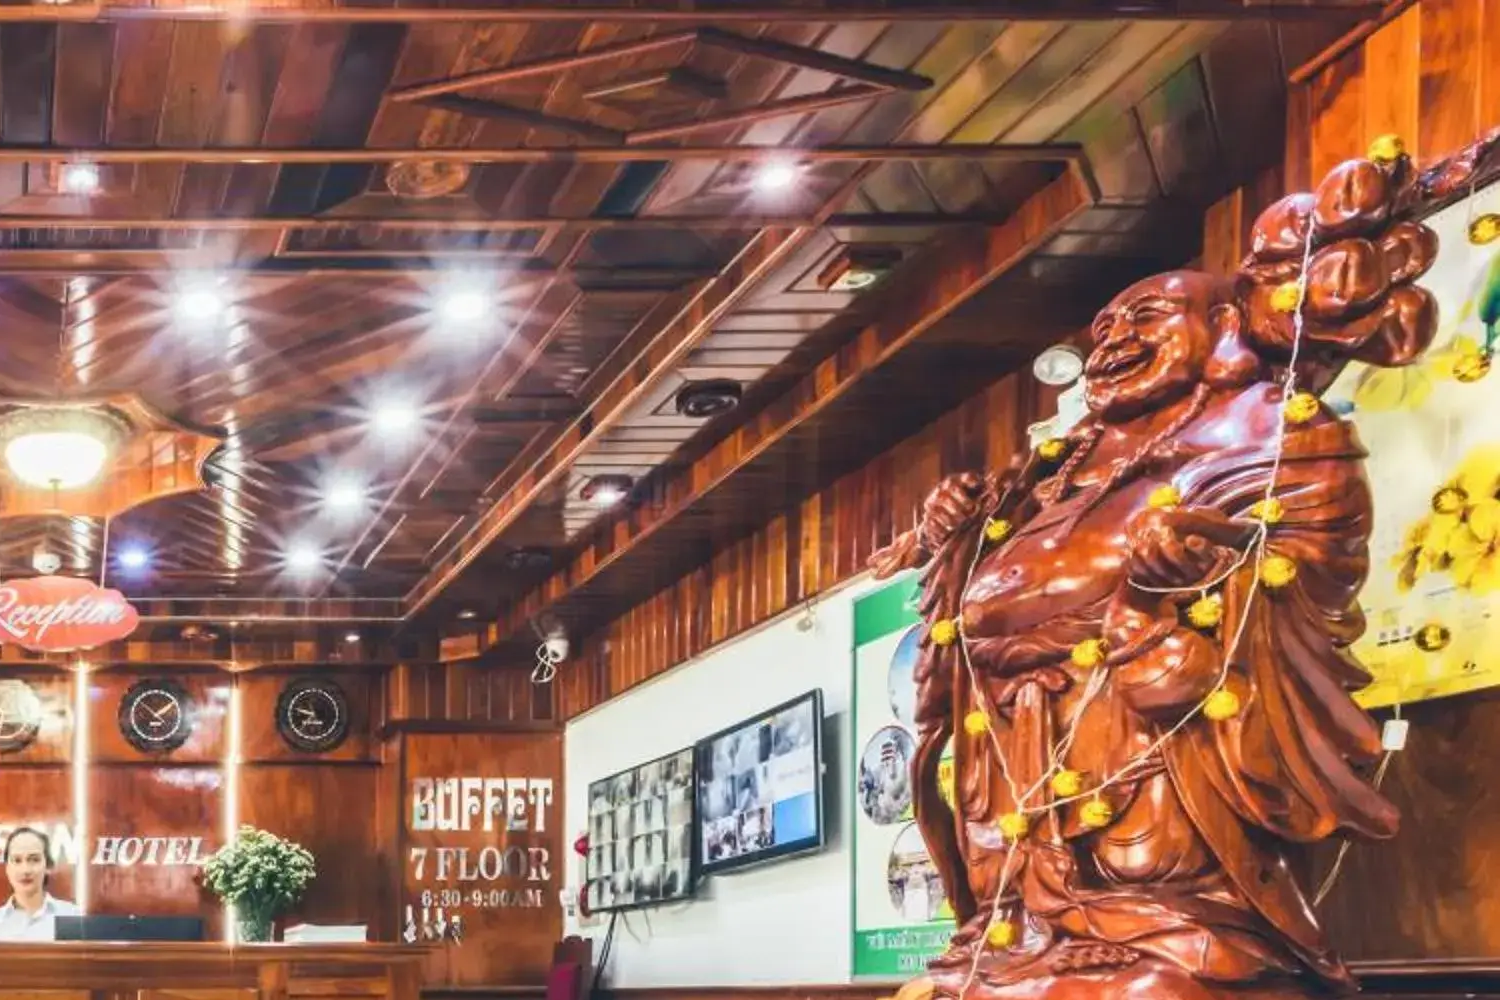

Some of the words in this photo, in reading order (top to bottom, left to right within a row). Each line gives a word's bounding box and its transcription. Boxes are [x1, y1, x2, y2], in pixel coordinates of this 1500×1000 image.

[412, 777, 553, 832] BUFFET
[91, 836, 206, 866] HOTEL
[410, 847, 427, 881] 7
[435, 846, 552, 881] FLOOR
